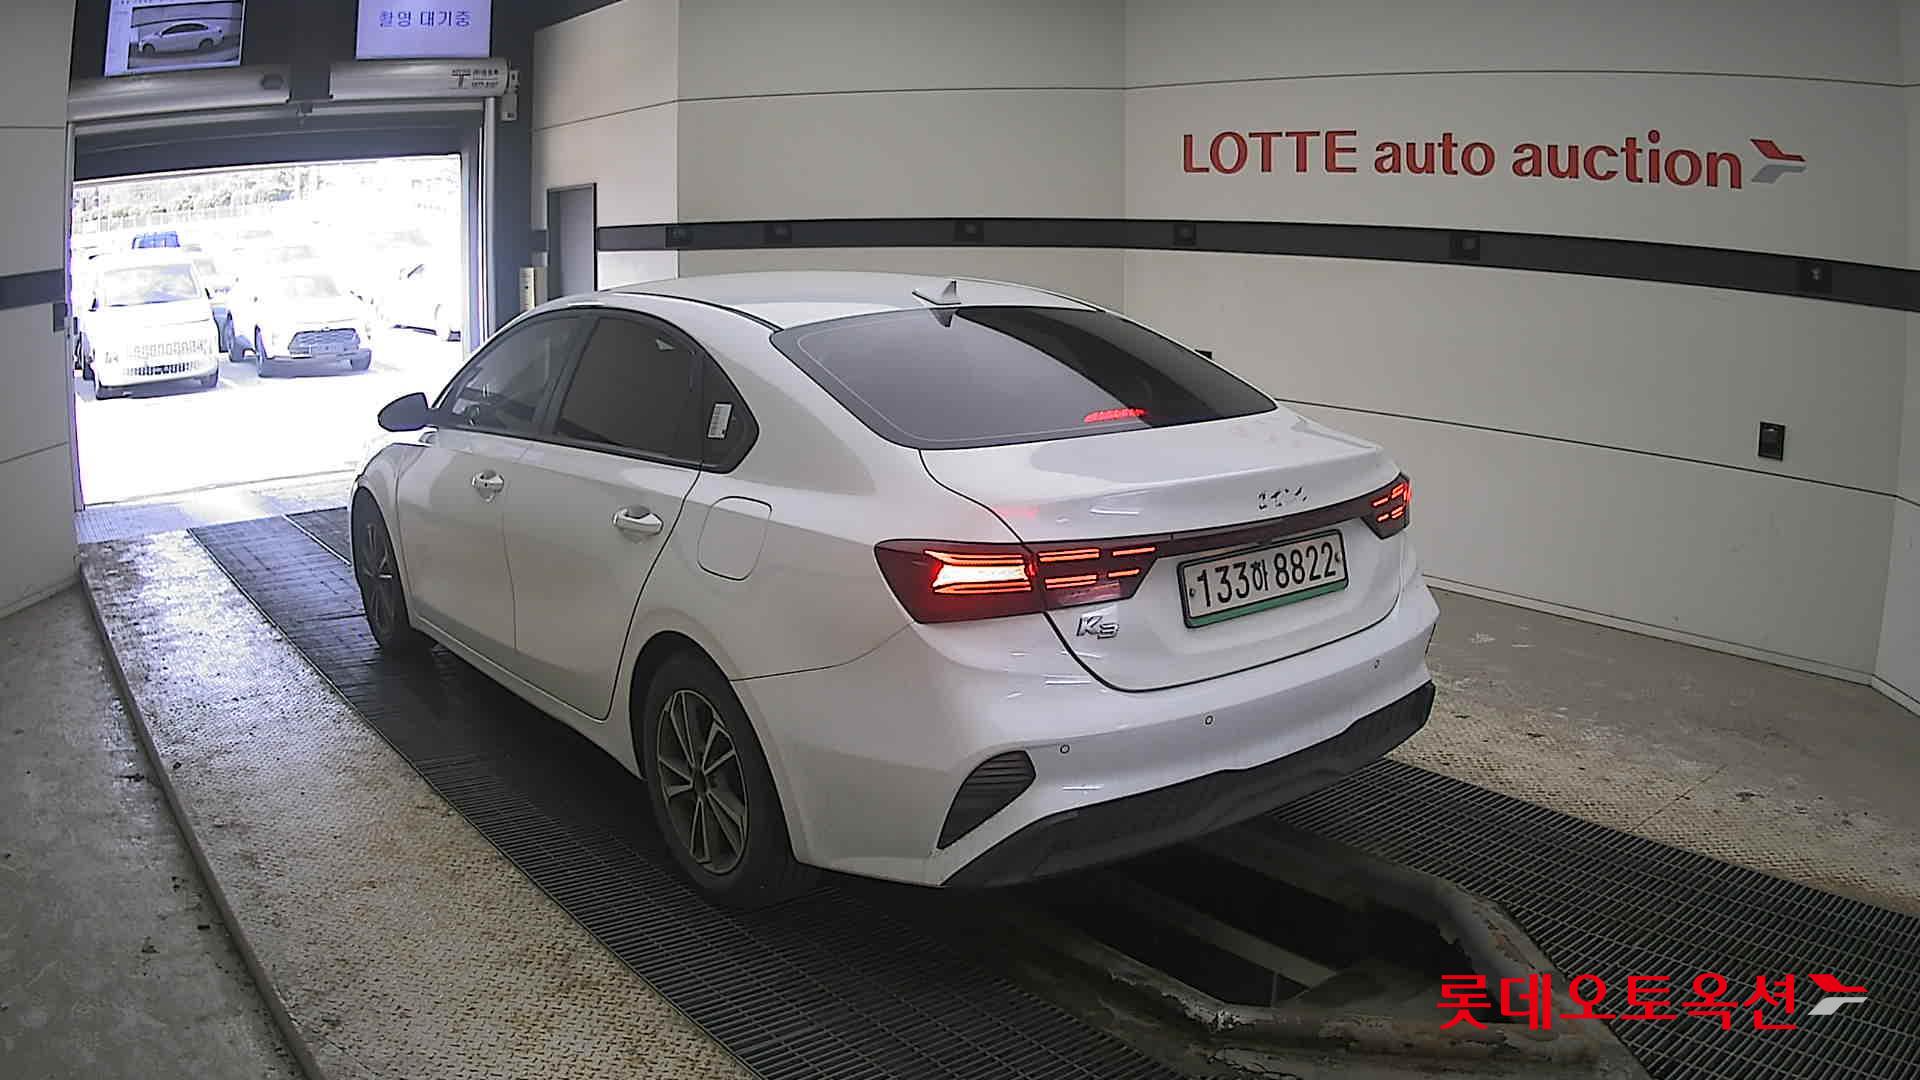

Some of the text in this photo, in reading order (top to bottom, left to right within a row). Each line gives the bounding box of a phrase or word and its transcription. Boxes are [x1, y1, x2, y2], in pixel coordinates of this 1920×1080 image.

[420, 10, 472, 27] 대기중
[1183, 129, 1743, 189] LOTTE auto auction
[1076, 616, 1120, 640] K3
